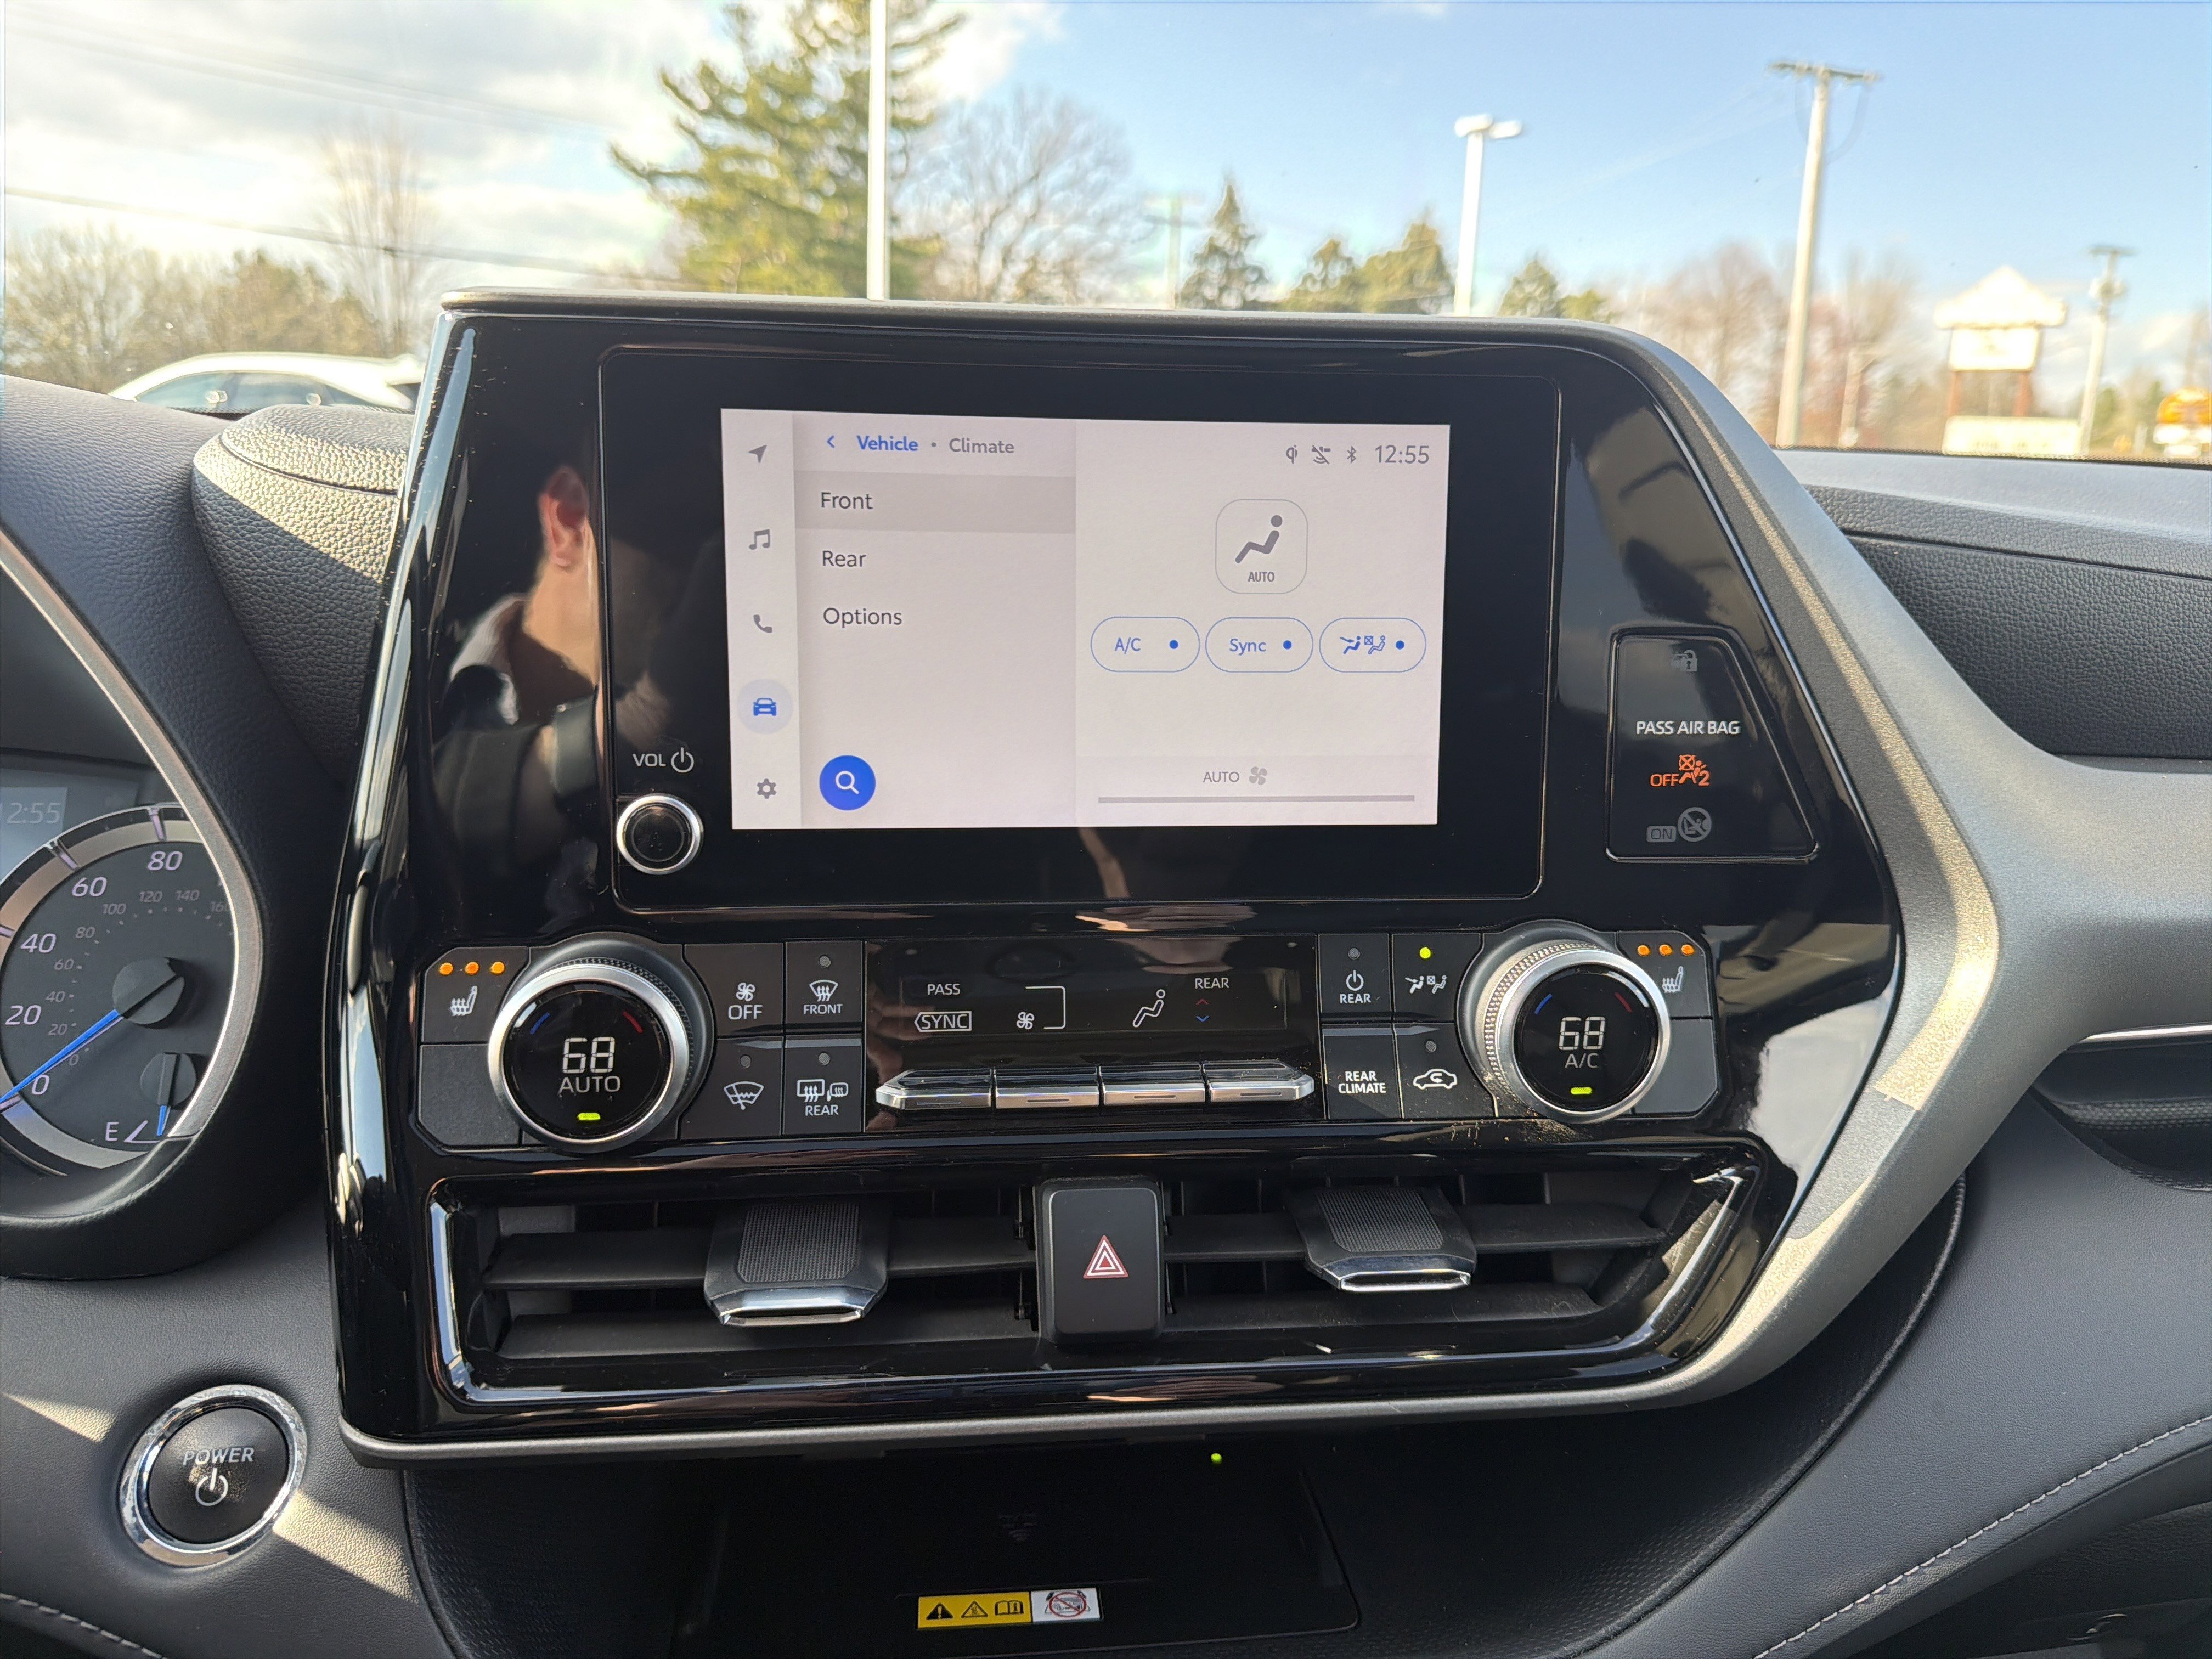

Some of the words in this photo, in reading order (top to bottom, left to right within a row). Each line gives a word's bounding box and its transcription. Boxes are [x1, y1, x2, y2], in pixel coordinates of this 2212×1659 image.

[857, 435, 919, 452] Vehicle
[949, 438, 1015, 454] Climate
[1374, 444, 1430, 464] 12:55
[821, 492, 874, 510] Front
[822, 550, 866, 568] Rear
[1248, 572, 1275, 583] AUTO
[822, 607, 903, 629] Options
[1115, 637, 1141, 654] A/C
[1229, 638, 1267, 656] Sync
[1637, 721, 1674, 735] PASS
[1677, 721, 1704, 735] AIR
[1707, 721, 1741, 735] BAG
[633, 753, 667, 767] VOL
[1203, 771, 1240, 783] AUTO
[1650, 774, 1679, 787] OFF
[1651, 828, 1673, 840] ON
[147, 851, 183, 871] 80
[71, 877, 107, 897] 60
[139, 891, 162, 903] 120
[176, 889, 200, 901] 140
[103, 903, 126, 915] 100
[75, 927, 95, 939] 80
[20, 933, 57, 953] 40
[54, 958, 75, 970] 60
[927, 984, 961, 996] PASS
[1195, 977, 1229, 989] REAR
[45, 991, 65, 1002] 40
[1340, 993, 1371, 1004] REAR
[5, 1005, 42, 1025] 20
[728, 1005, 762, 1020] OFF
[803, 1004, 843, 1015] FRONT
[921, 1014, 968, 1030] SYNC
[48, 1024, 68, 1036] 20
[1559, 1017, 1605, 1051] 68
[69, 1054, 79, 1066] 0
[562, 1037, 616, 1074] 68
[1565, 1053, 1599, 1069] A/C
[1345, 1070, 1376, 1081] REAR
[31, 1075, 49, 1096] 0
[559, 1076, 621, 1093] AUTO
[1338, 1082, 1386, 1094] CLIMATE
[805, 1104, 839, 1116] REAR
[105, 1122, 119, 1142] E
[182, 1447, 255, 1466] POWER
